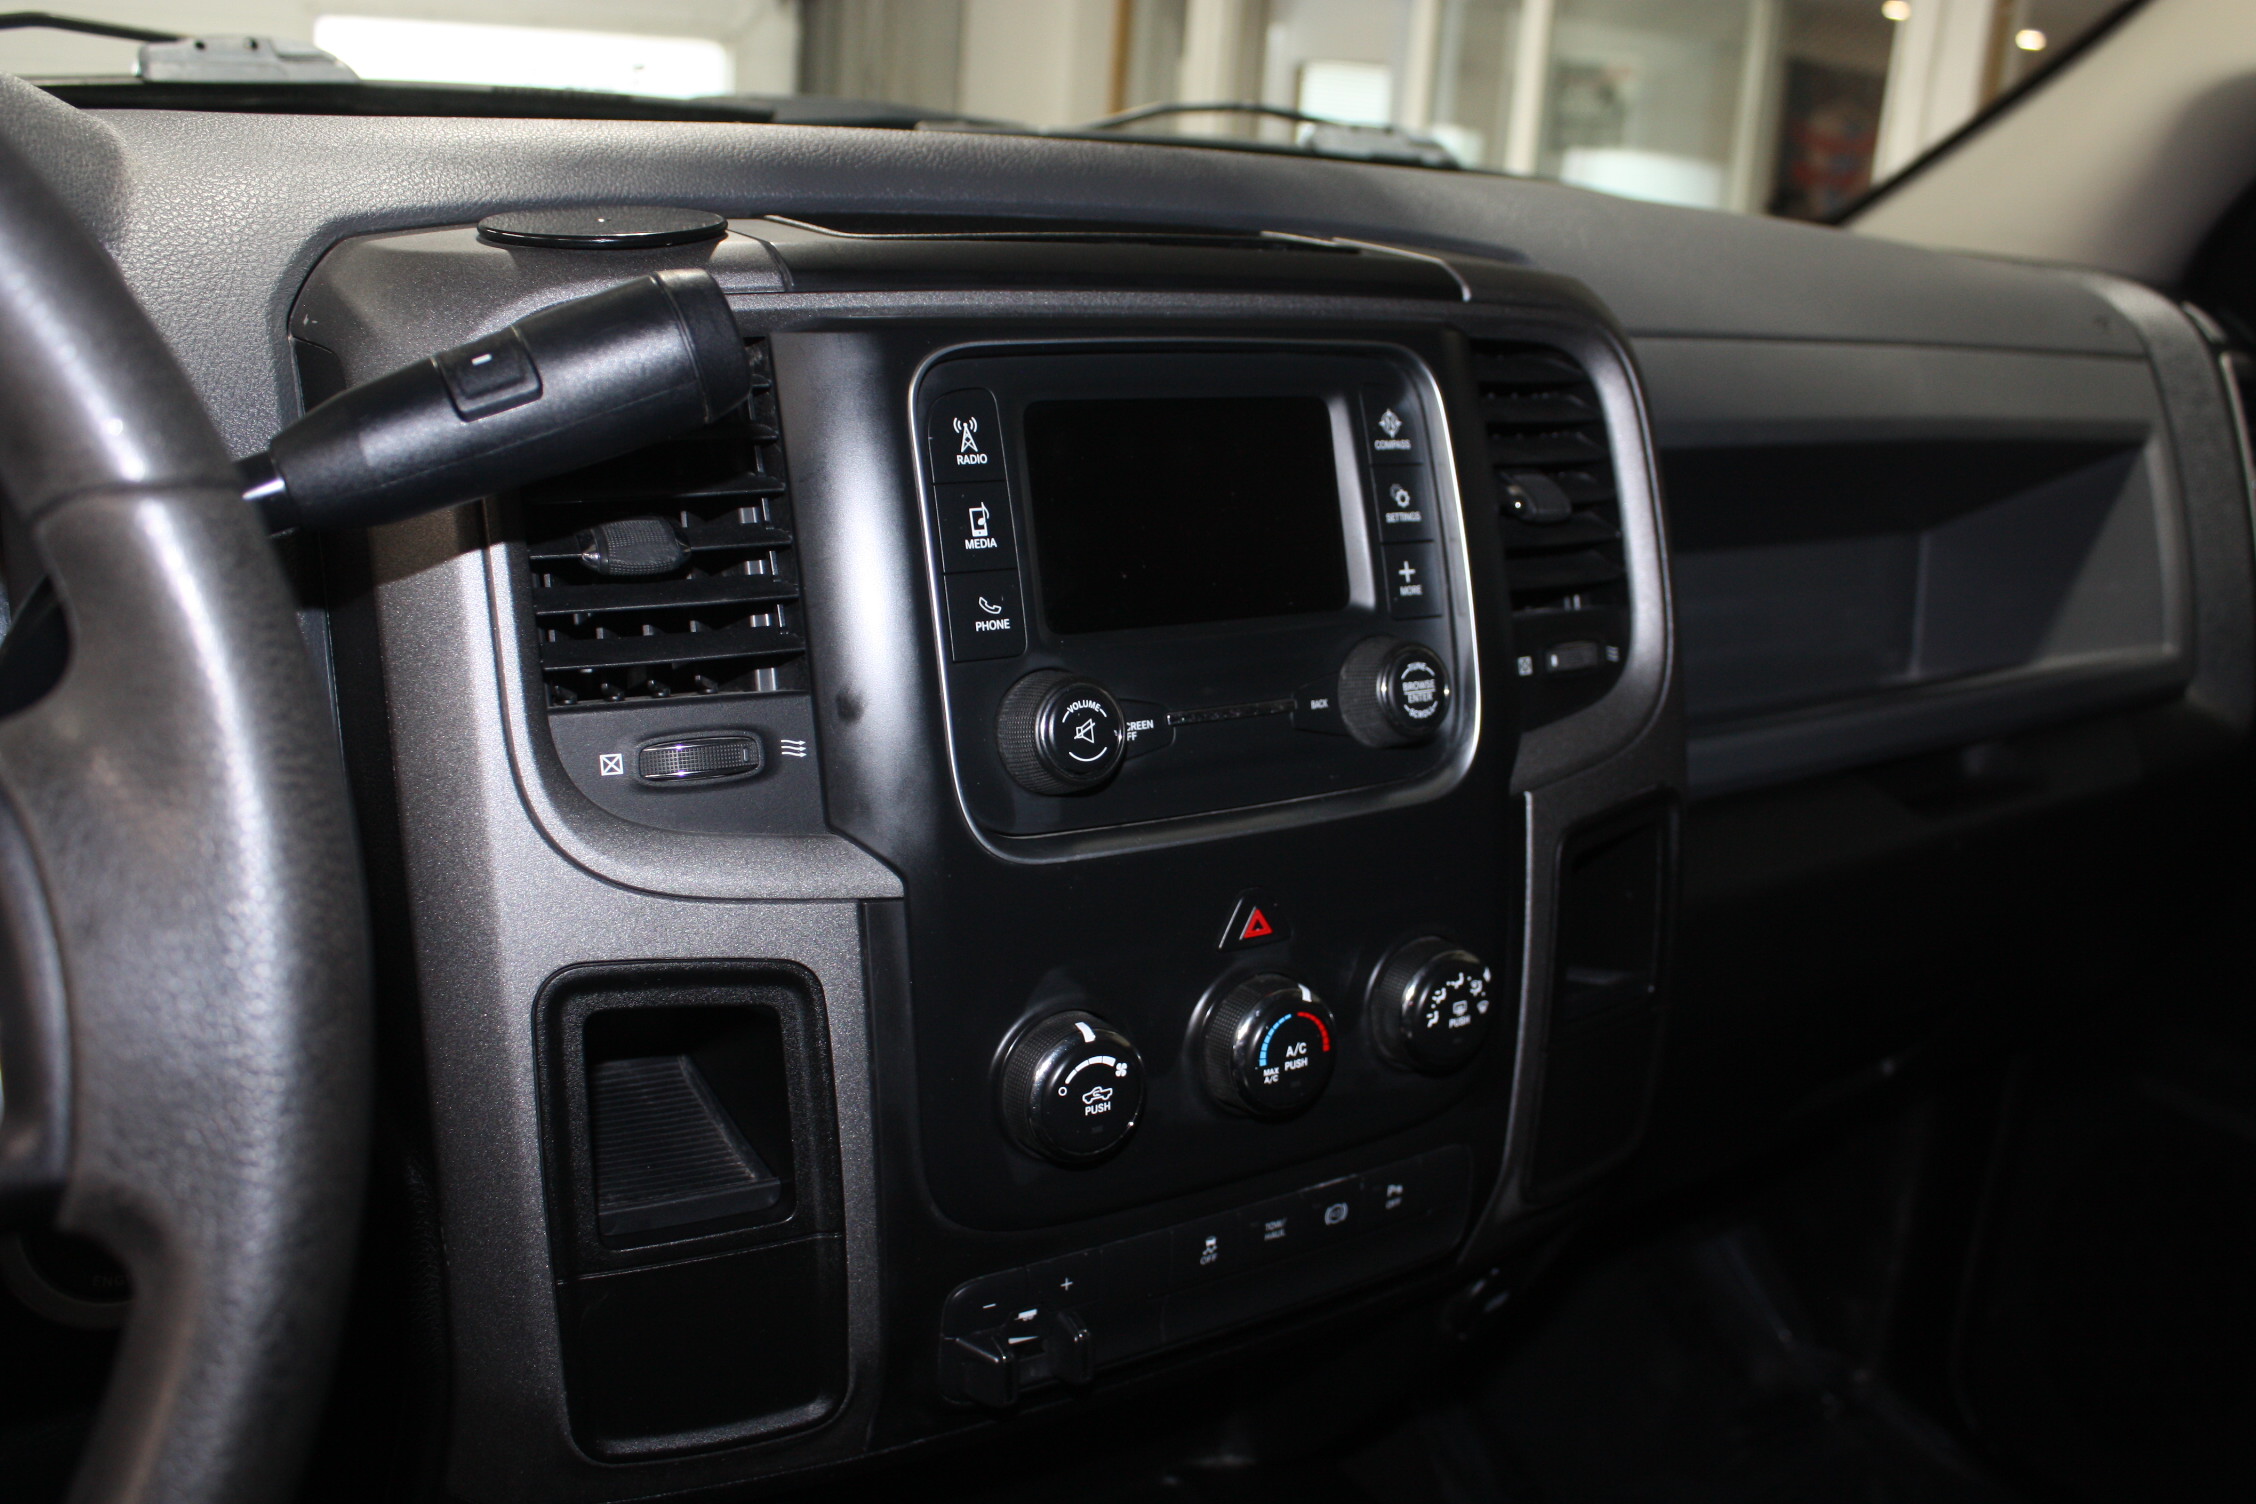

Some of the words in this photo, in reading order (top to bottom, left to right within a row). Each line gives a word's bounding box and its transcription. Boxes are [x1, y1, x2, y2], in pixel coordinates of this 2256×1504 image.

[1374, 439, 1411, 450] COMPASS
[956, 453, 988, 465] RADIO
[1385, 511, 1421, 523] SETTINGS
[965, 537, 997, 550] MEDIA
[1400, 585, 1422, 596] MORE
[975, 618, 1011, 632] PHONE
[1402, 679, 1435, 691] BROWSE
[1407, 691, 1433, 704] ENTER
[1066, 699, 1101, 713] VOLUME
[1310, 698, 1328, 710] BACK
[1126, 719, 1154, 731] CREEN
[1126, 731, 1138, 742] FF
[1285, 1042, 1307, 1058] A/C
[1284, 1057, 1308, 1071] PUSH
[1263, 1067, 1280, 1076] MAX
[1263, 1074, 1280, 1084] A/C
[1084, 1101, 1111, 1116] PUSH
[1199, 1253, 1217, 1266] OFF
[92, 1274, 127, 1288] ENG
